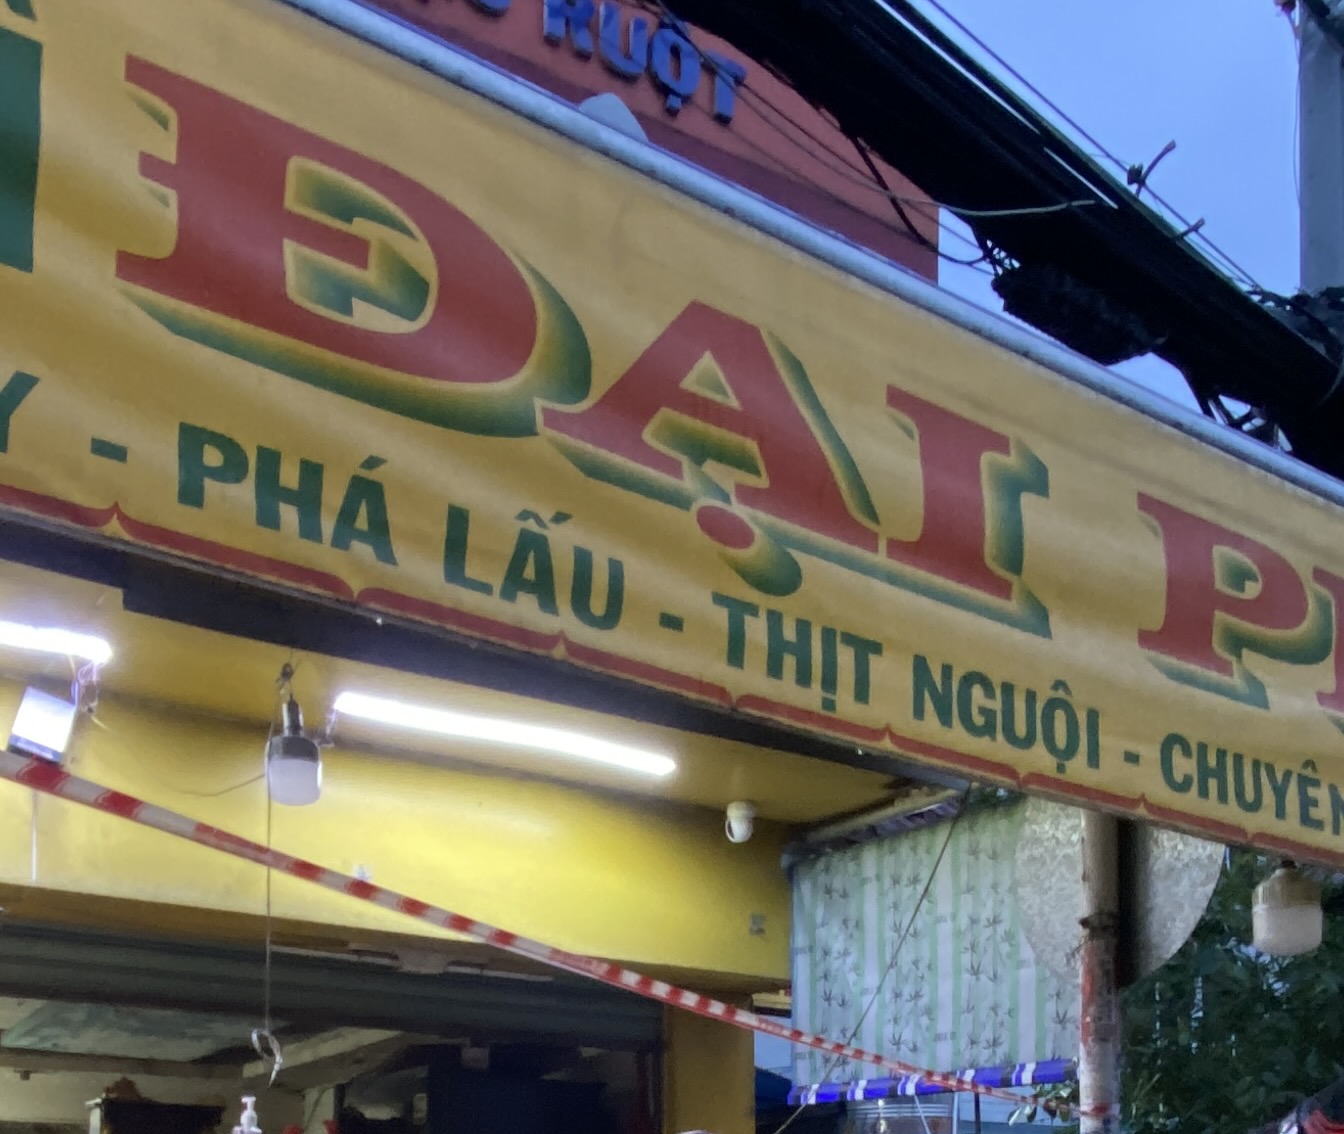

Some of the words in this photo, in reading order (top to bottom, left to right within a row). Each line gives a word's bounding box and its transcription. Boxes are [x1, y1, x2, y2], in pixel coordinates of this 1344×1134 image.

[116, 53, 1049, 636] ĐẠI
[177, 421, 398, 568] PHÁ
[444, 504, 625, 631] LẤU
[711, 592, 883, 712] THỊT
[912, 654, 1101, 775] NGUỘI
